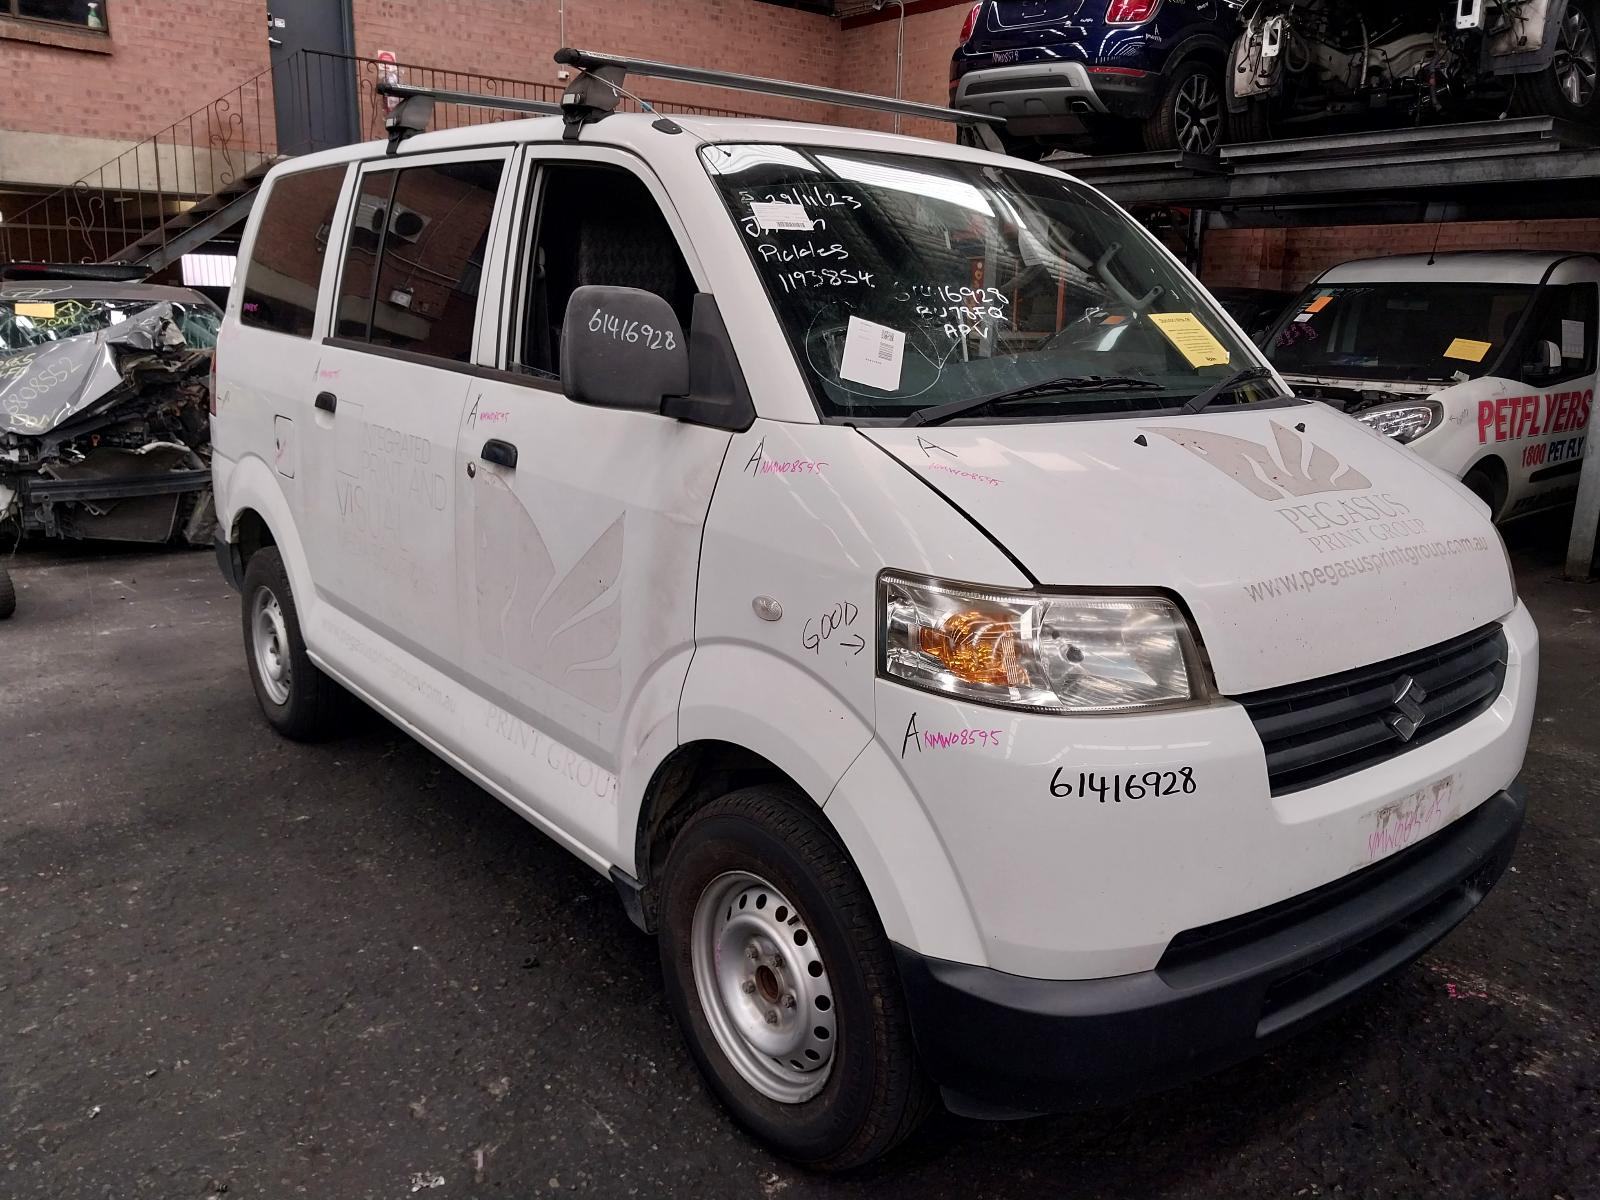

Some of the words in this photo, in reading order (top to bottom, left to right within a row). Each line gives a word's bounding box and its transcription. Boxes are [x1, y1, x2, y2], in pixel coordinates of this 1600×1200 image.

[588, 308, 677, 351] 61416928
[943, 323, 989, 340] APV
[1478, 389, 1594, 444] PETFLYERS
[743, 435, 765, 477] A
[916, 435, 958, 457] A
[1522, 442, 1547, 469] 1800
[1547, 439, 1565, 464] PET
[1566, 436, 1585, 459] FLY
[1274, 493, 1411, 534] PEGASUS
[1307, 527, 1369, 554] PRINT
[1244, 535, 1489, 603] www.pegasusprintgroup.com.au
[802, 601, 859, 655] GOOD
[902, 711, 922, 760] A
[924, 729, 1003, 749] NMW08595
[1049, 765, 1197, 803] 61416928
